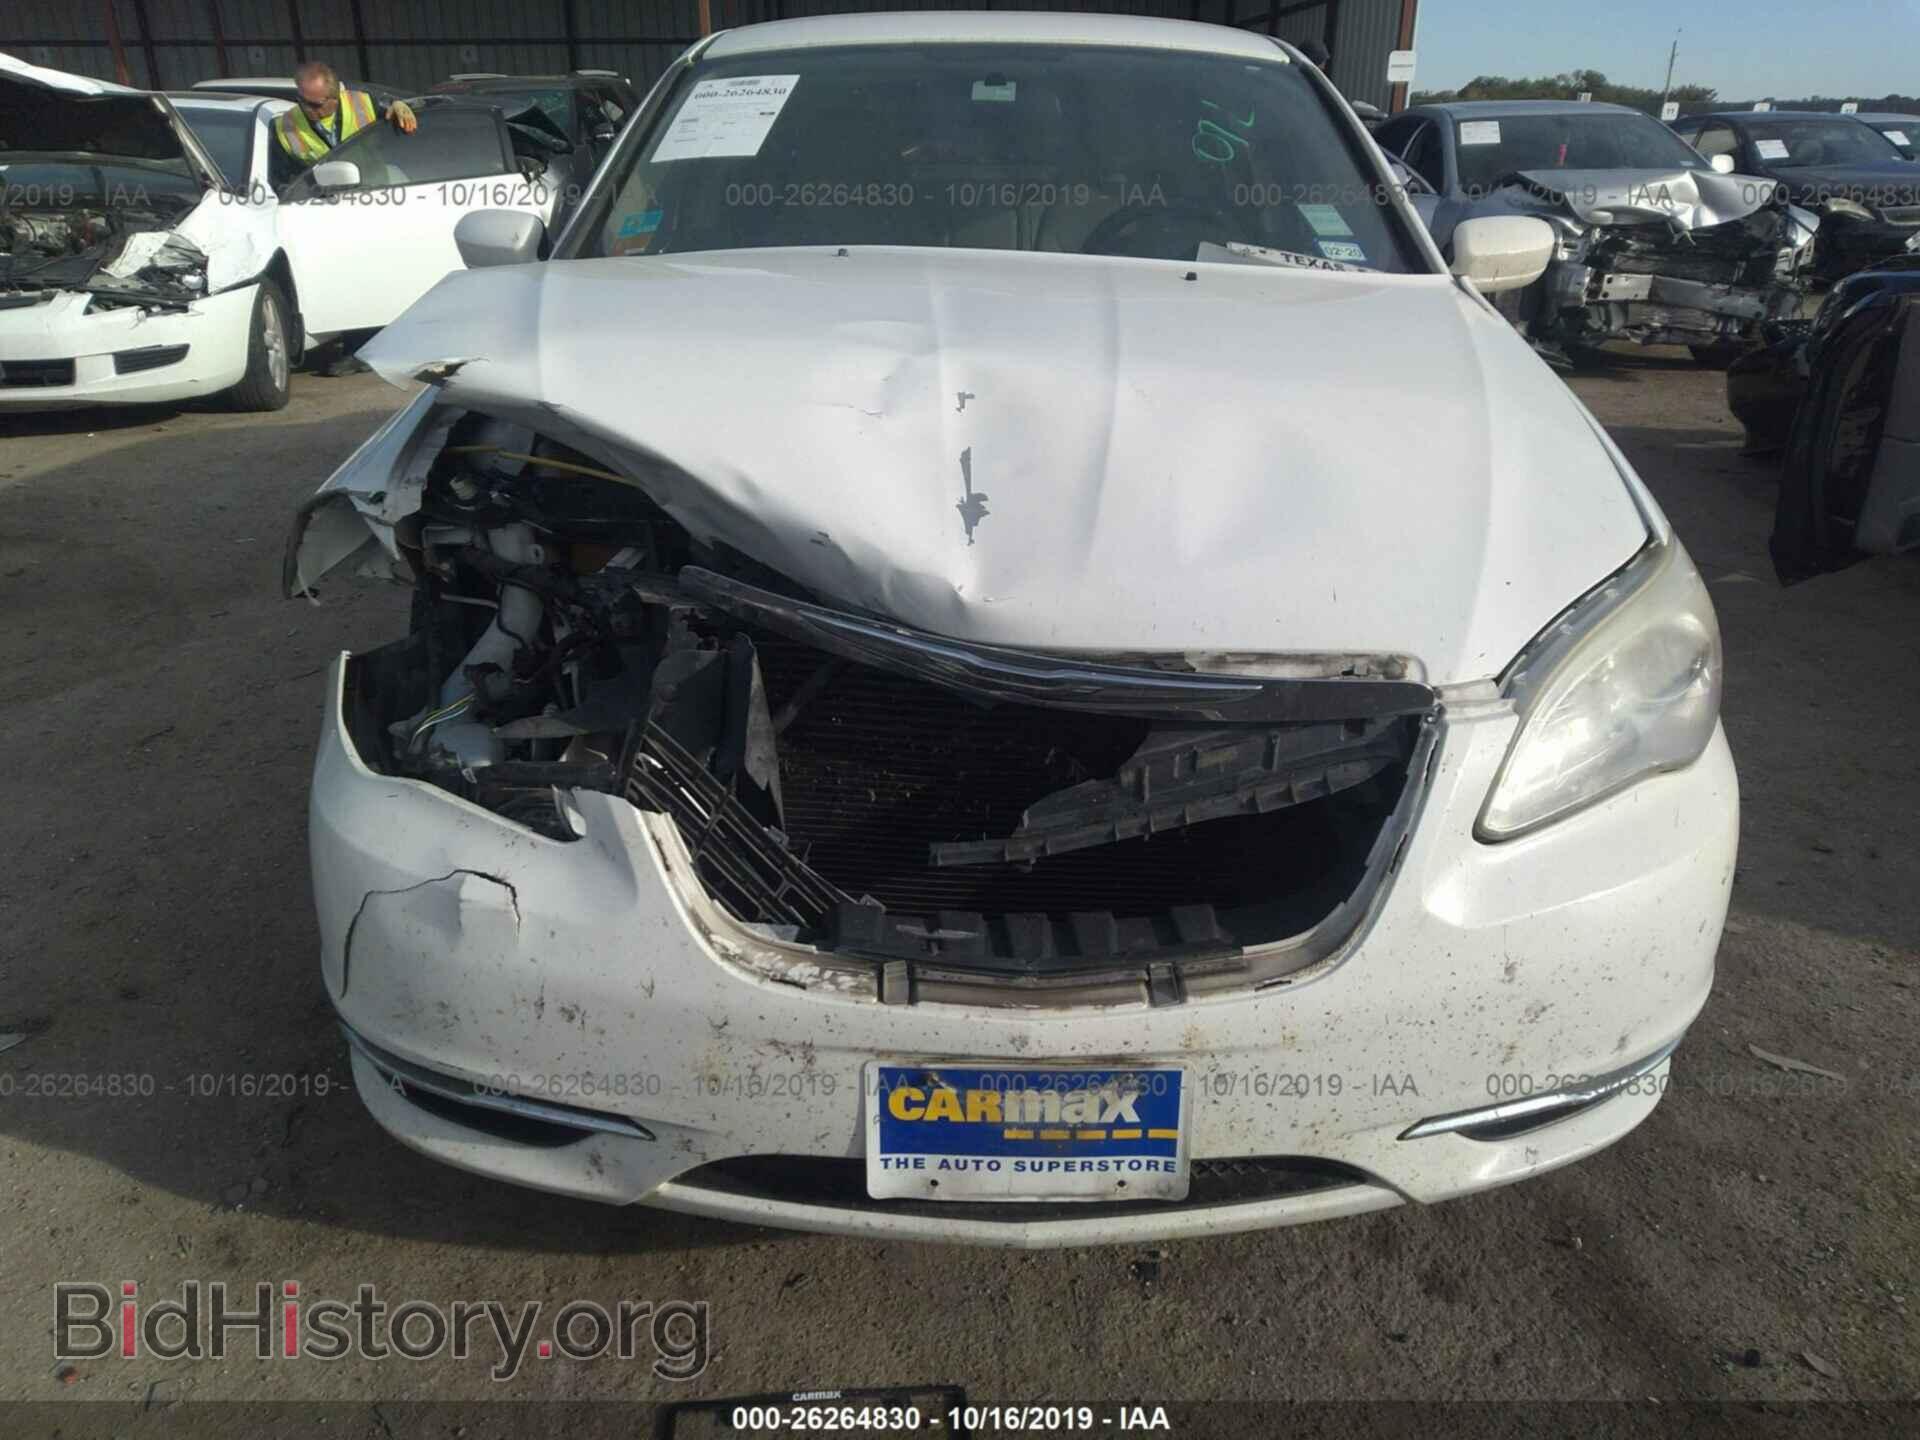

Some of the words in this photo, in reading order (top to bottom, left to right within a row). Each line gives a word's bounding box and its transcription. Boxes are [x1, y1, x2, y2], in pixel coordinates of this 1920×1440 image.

[1280, 252, 1346, 272] TEXAS
[887, 1086, 1142, 1124] CARmax
[880, 1157, 926, 1170] THE
[938, 1158, 1002, 1172] AUTO
[1013, 1158, 1177, 1173] SUPERSTORE
